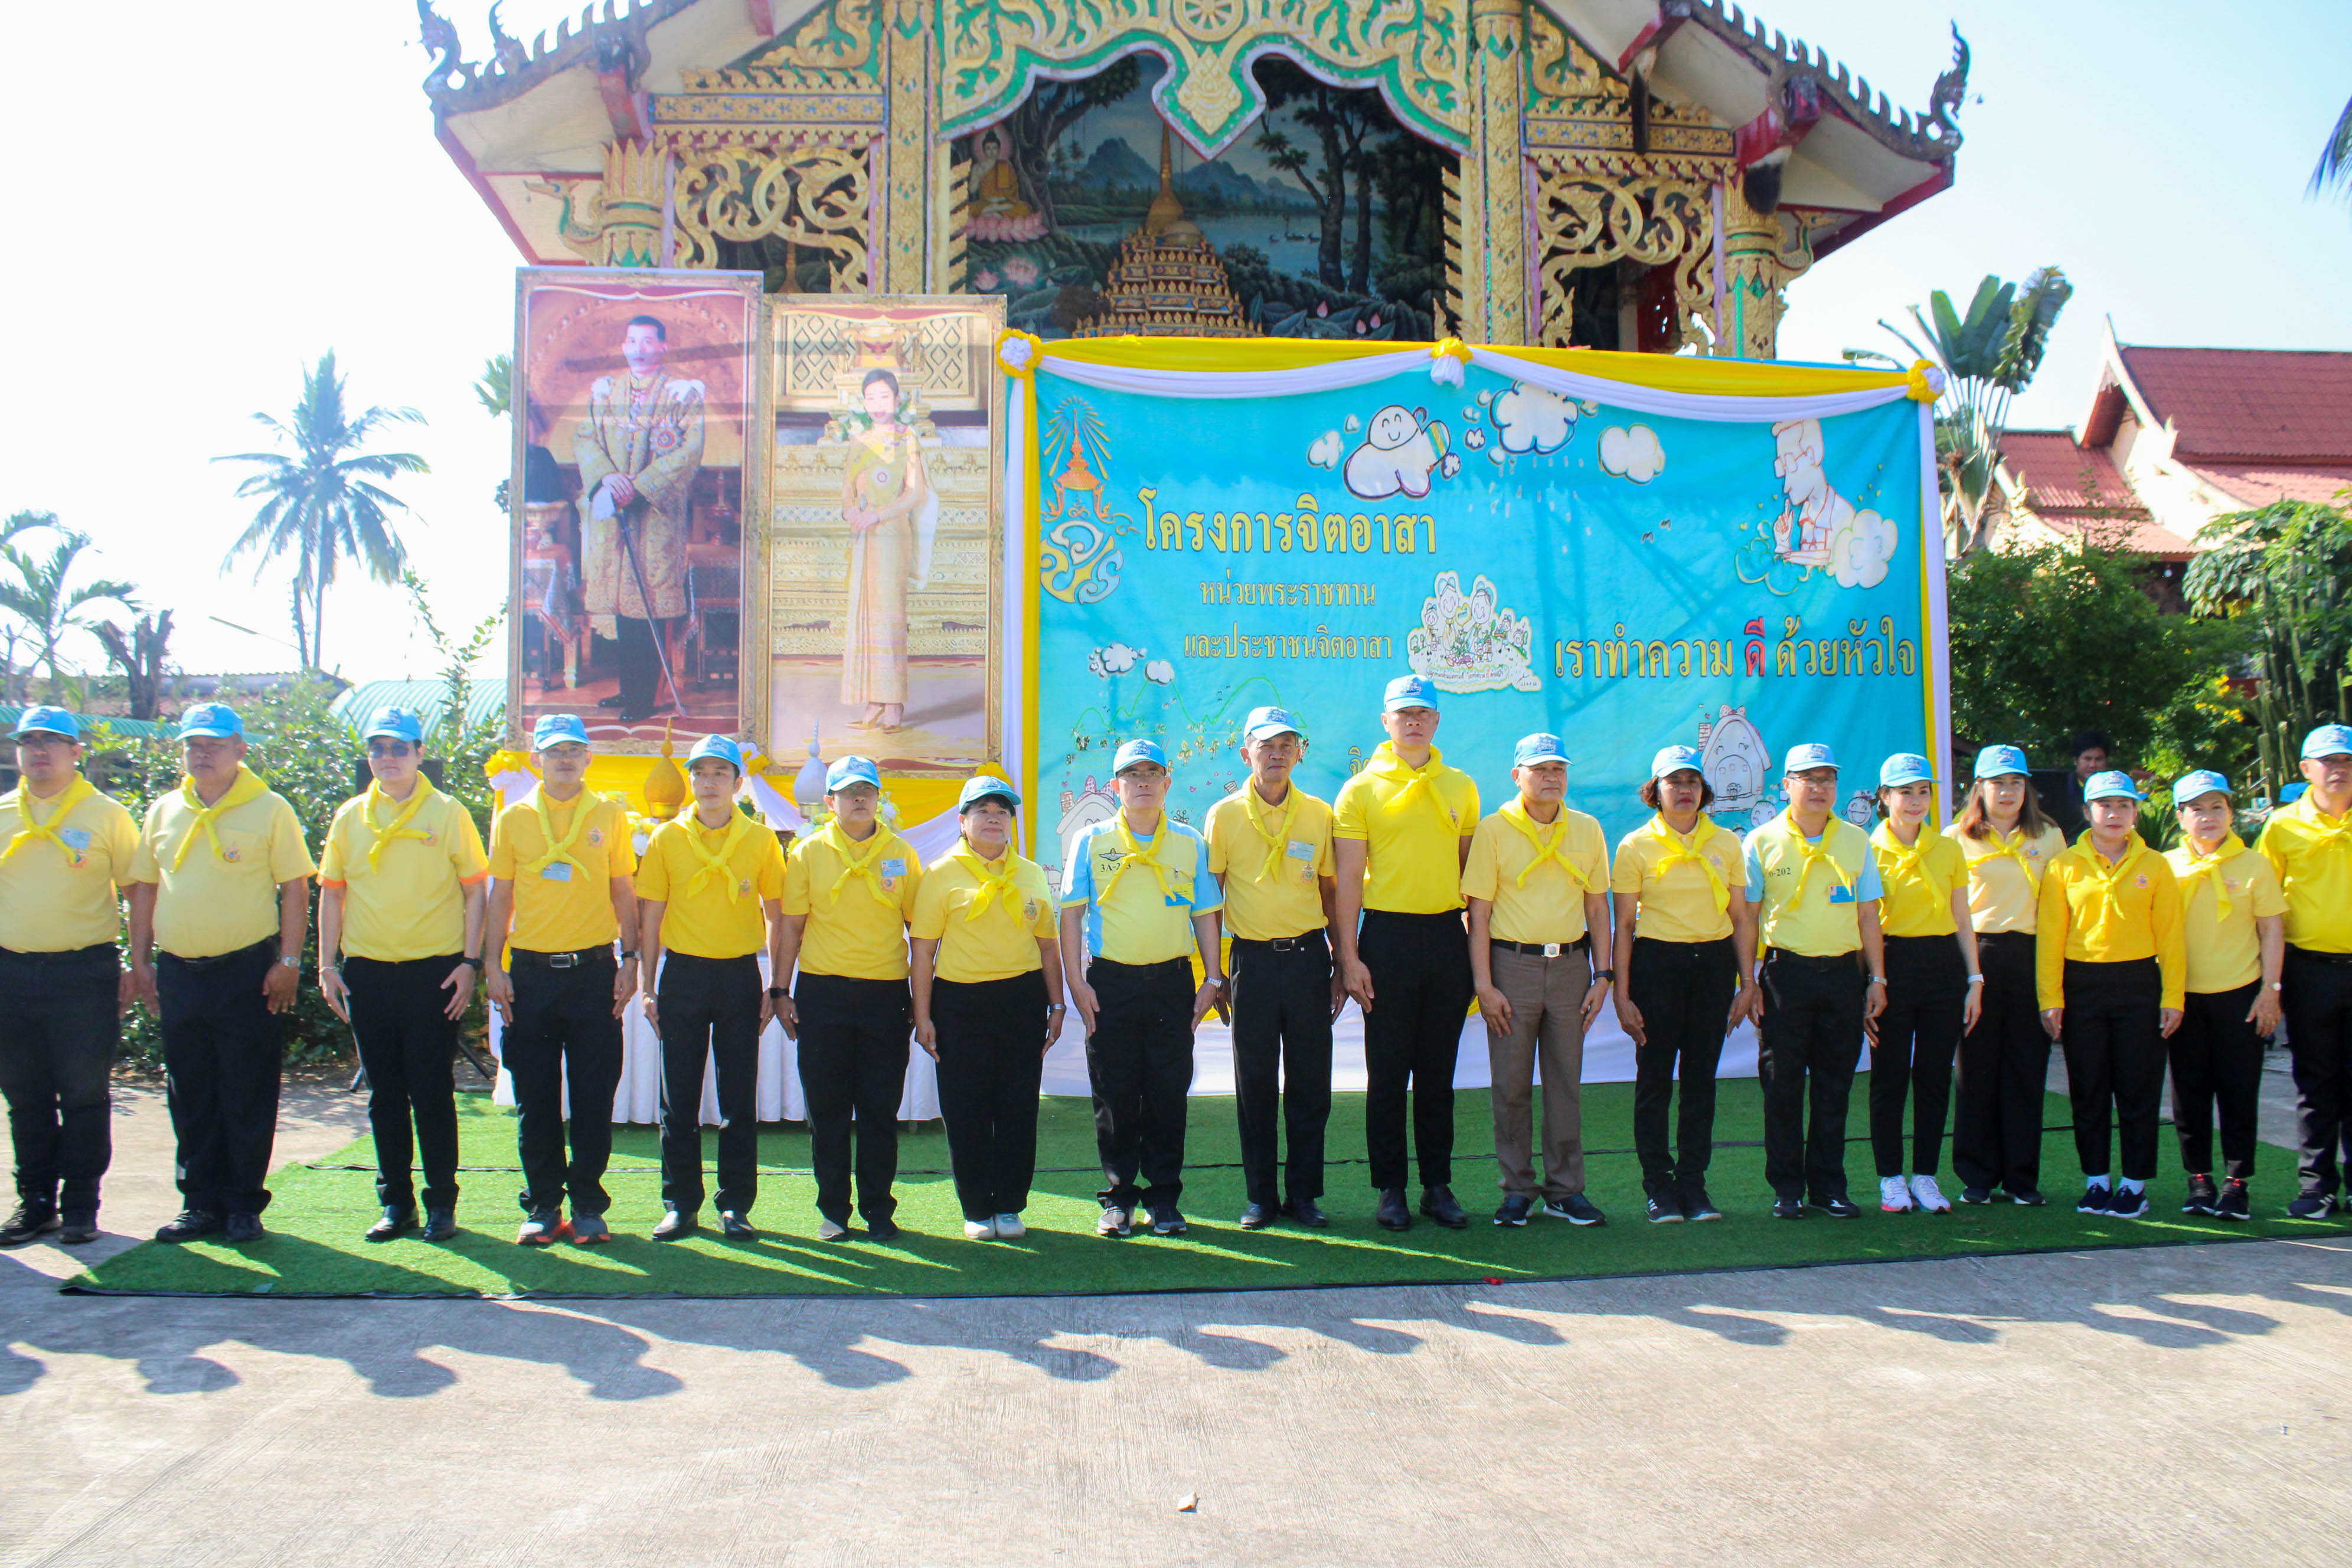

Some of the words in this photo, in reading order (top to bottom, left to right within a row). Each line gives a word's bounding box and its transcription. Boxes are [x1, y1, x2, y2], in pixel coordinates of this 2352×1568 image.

[1138, 488, 1436, 553] โครงการจิตอาสา
[1200, 569, 1376, 606] หน่วยพระราชทาน
[1185, 622, 1391, 658] และประชาชนจิตอาสา
[1554, 622, 1734, 677] เราทำความ
[1744, 616, 1766, 677] ดี
[1776, 616, 1917, 677] ด้วยหัวใจ
